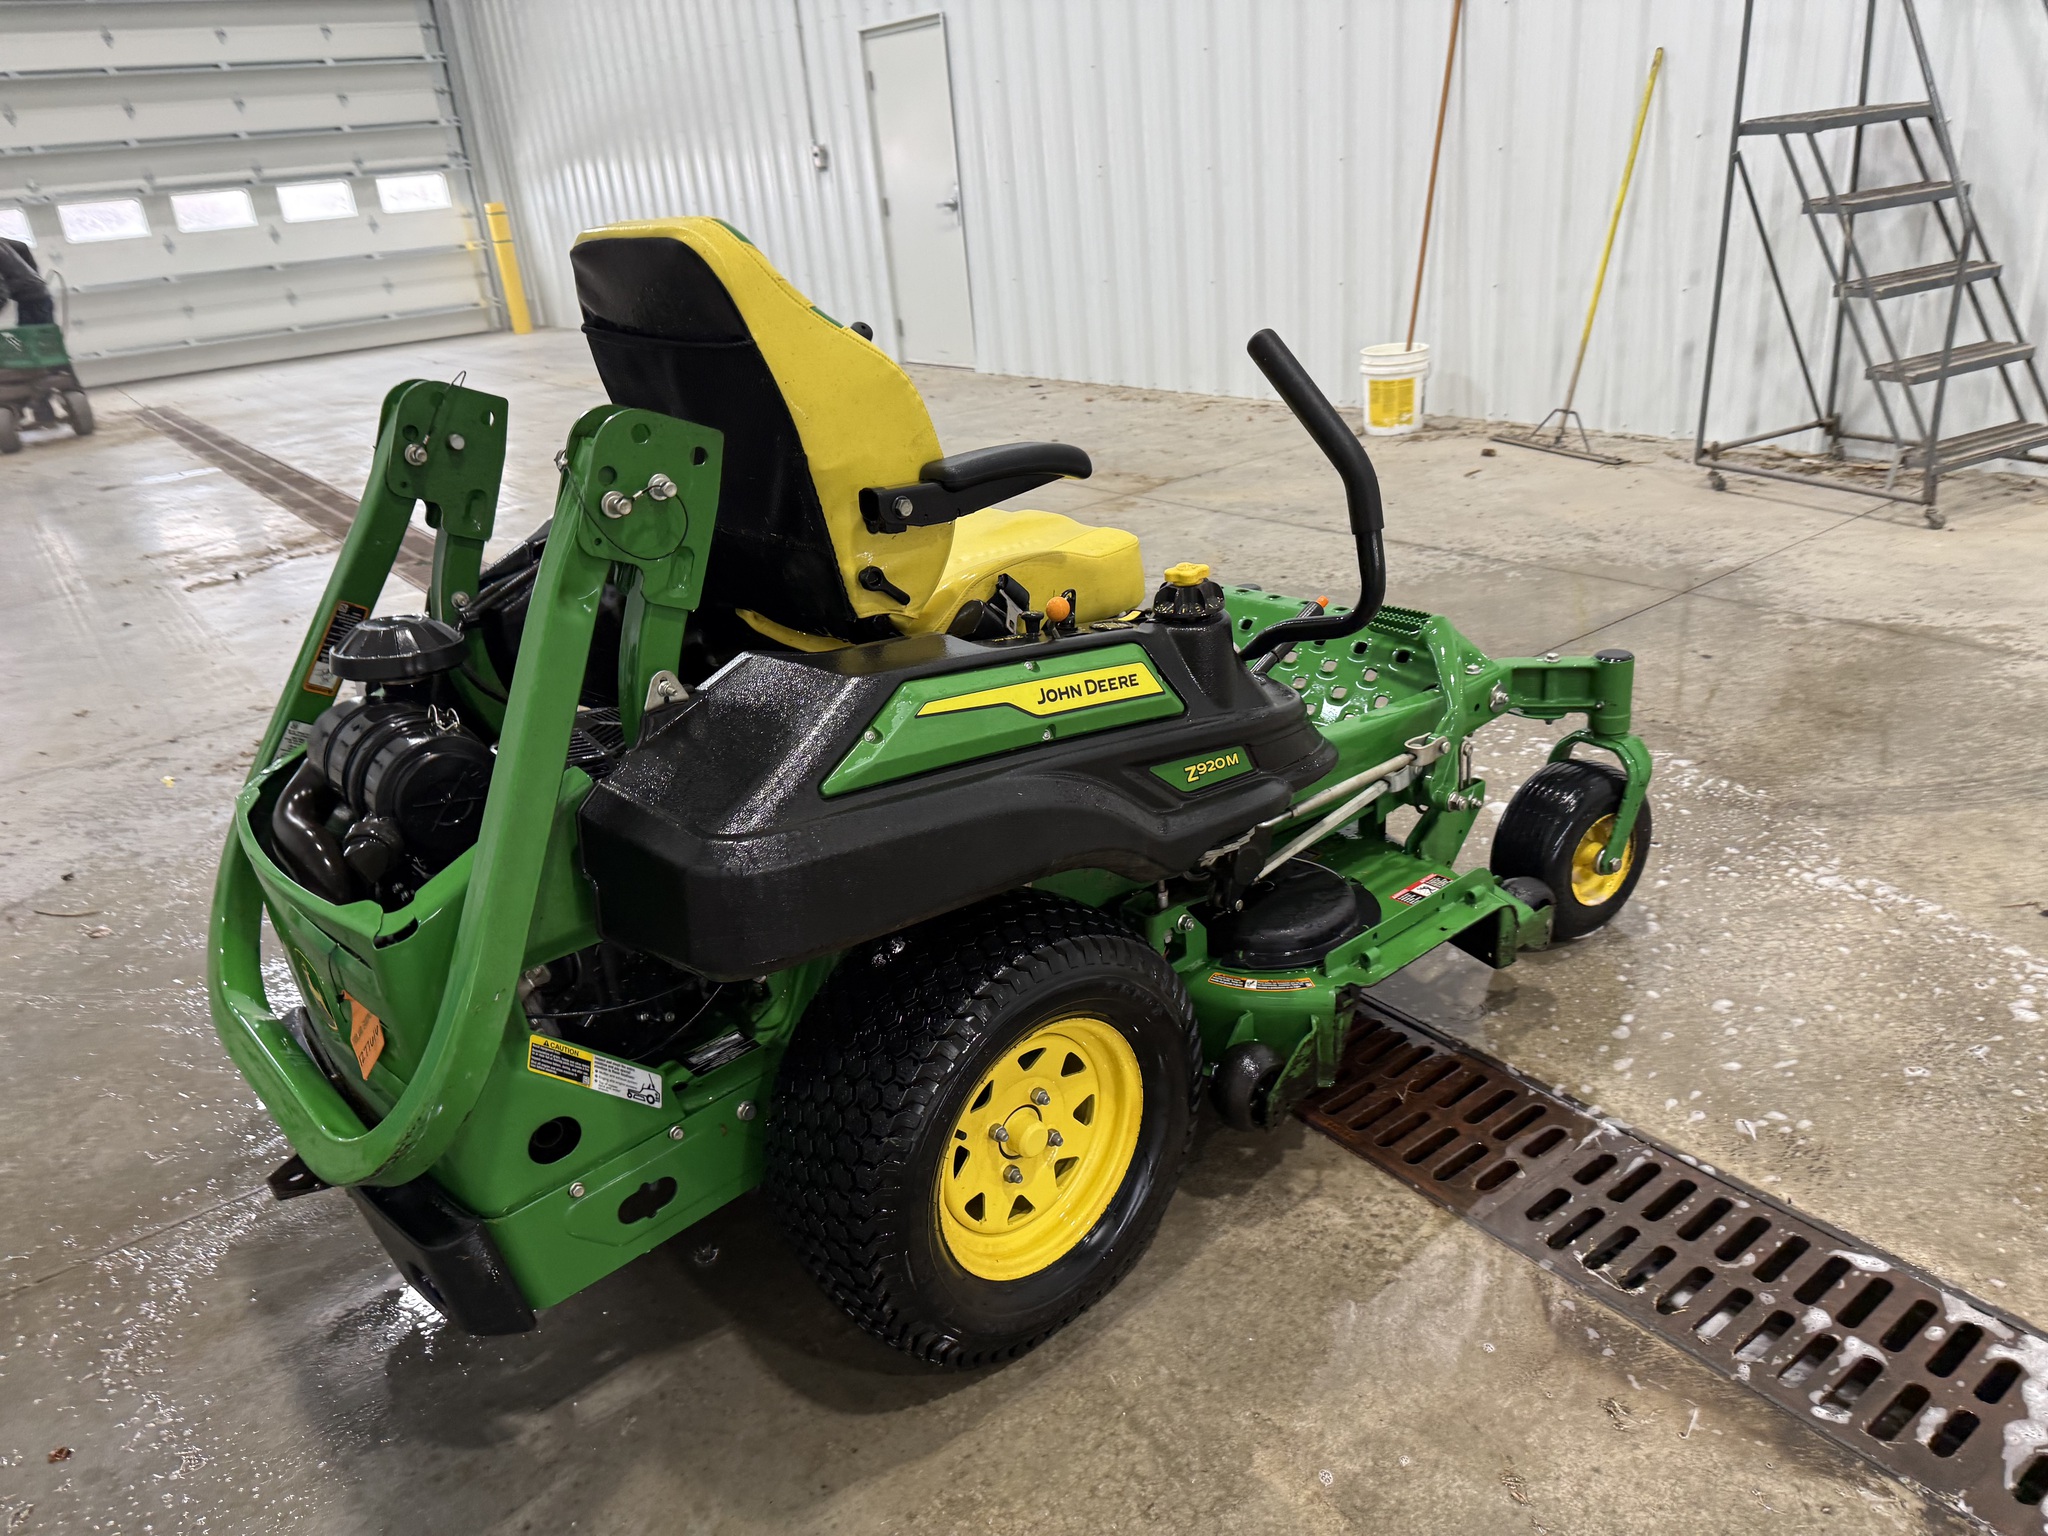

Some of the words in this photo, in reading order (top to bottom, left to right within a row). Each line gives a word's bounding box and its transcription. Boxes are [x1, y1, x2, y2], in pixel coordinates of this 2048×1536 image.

[1037, 684, 1082, 705] JOHN
[1084, 673, 1139, 696] DEERE
[1184, 752, 1240, 783] Z920M
[550, 1042, 580, 1057] CAUTION
